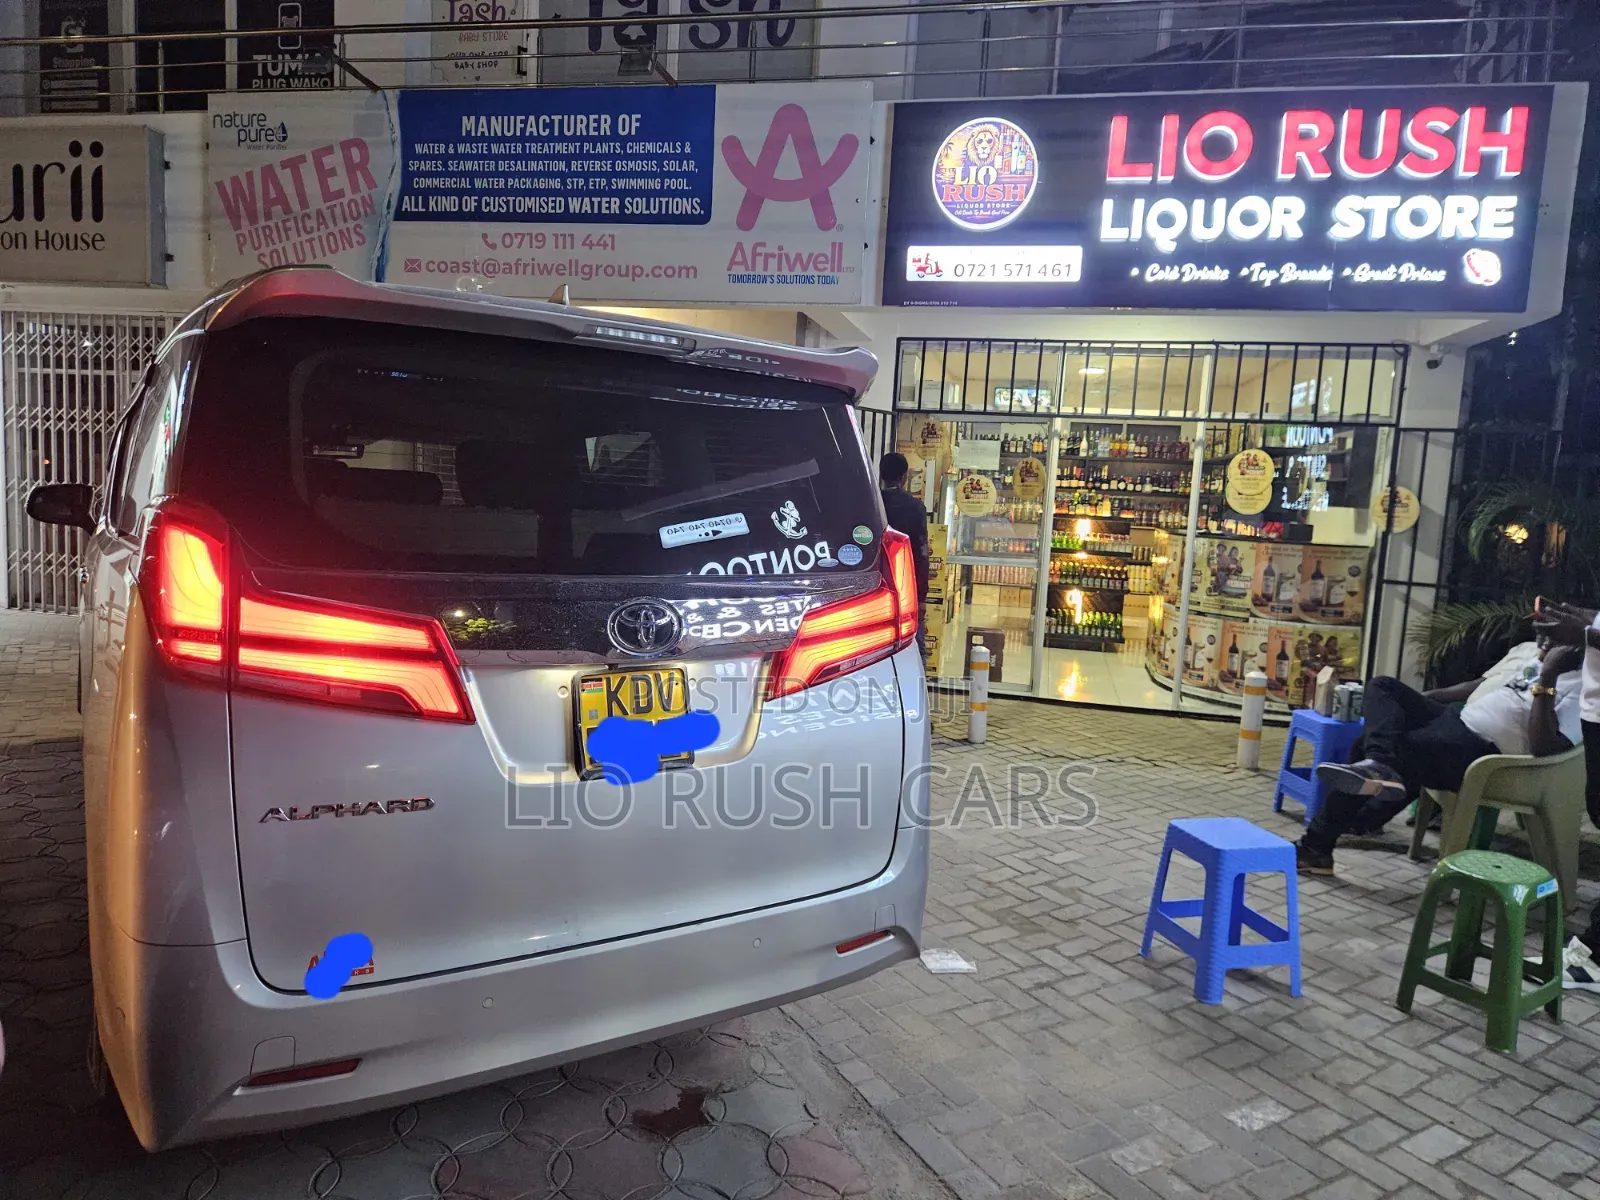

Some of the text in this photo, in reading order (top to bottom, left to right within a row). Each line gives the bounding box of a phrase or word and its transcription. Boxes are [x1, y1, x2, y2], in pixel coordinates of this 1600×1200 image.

[253, 53, 328, 77] TUM
[454, 60, 499, 70] BABY SHOP
[213, 111, 268, 129] nature
[461, 113, 642, 137] MANUFACTURER OF
[237, 128, 275, 148] pure
[414, 142, 692, 155] WATER & WASTE WATER TREATMENT PLANTS, CHEMICALS &
[1105, 106, 1530, 183] LIO RUSH
[447, 160, 496, 172] SEAWATER
[498, 160, 569, 173] DESALINATION,
[571, 160, 613, 172] REVERSE
[615, 160, 660, 173] OSMOSIS,
[662, 160, 699, 174] SOLAR,
[953, 165, 998, 186] LIO
[214, 137, 379, 232] WATER
[413, 178, 693, 191] COMMERCIAL WATER PACKAGING, STP, ETP, SWIMMING POOL.
[941, 184, 1028, 202] RUSH
[401, 195, 705, 215] ALL KIND OF CUSTOMISED WATER SOLUTIONS.
[235, 193, 377, 256] PURIFICATION
[1100, 194, 1518, 252] LIQUOR STORE
[35, 229, 106, 251] House
[257, 223, 367, 269] SOLUTIONS
[501, 232, 617, 251] 0719 111 441
[726, 241, 844, 273] Afriwell
[425, 257, 699, 282] coast@afriwellgroup.com
[727, 273, 839, 286] TOMORROW'S SOLUTIONS TODAY
[953, 263, 1073, 278] 0721 571 461
[1145, 263, 1180, 282] Cold
[1181, 263, 1230, 282] Drinks
[1250, 262, 1279, 288] Top
[605, 671, 676, 717] KDV
[258, 797, 437, 824] ALPHARD
